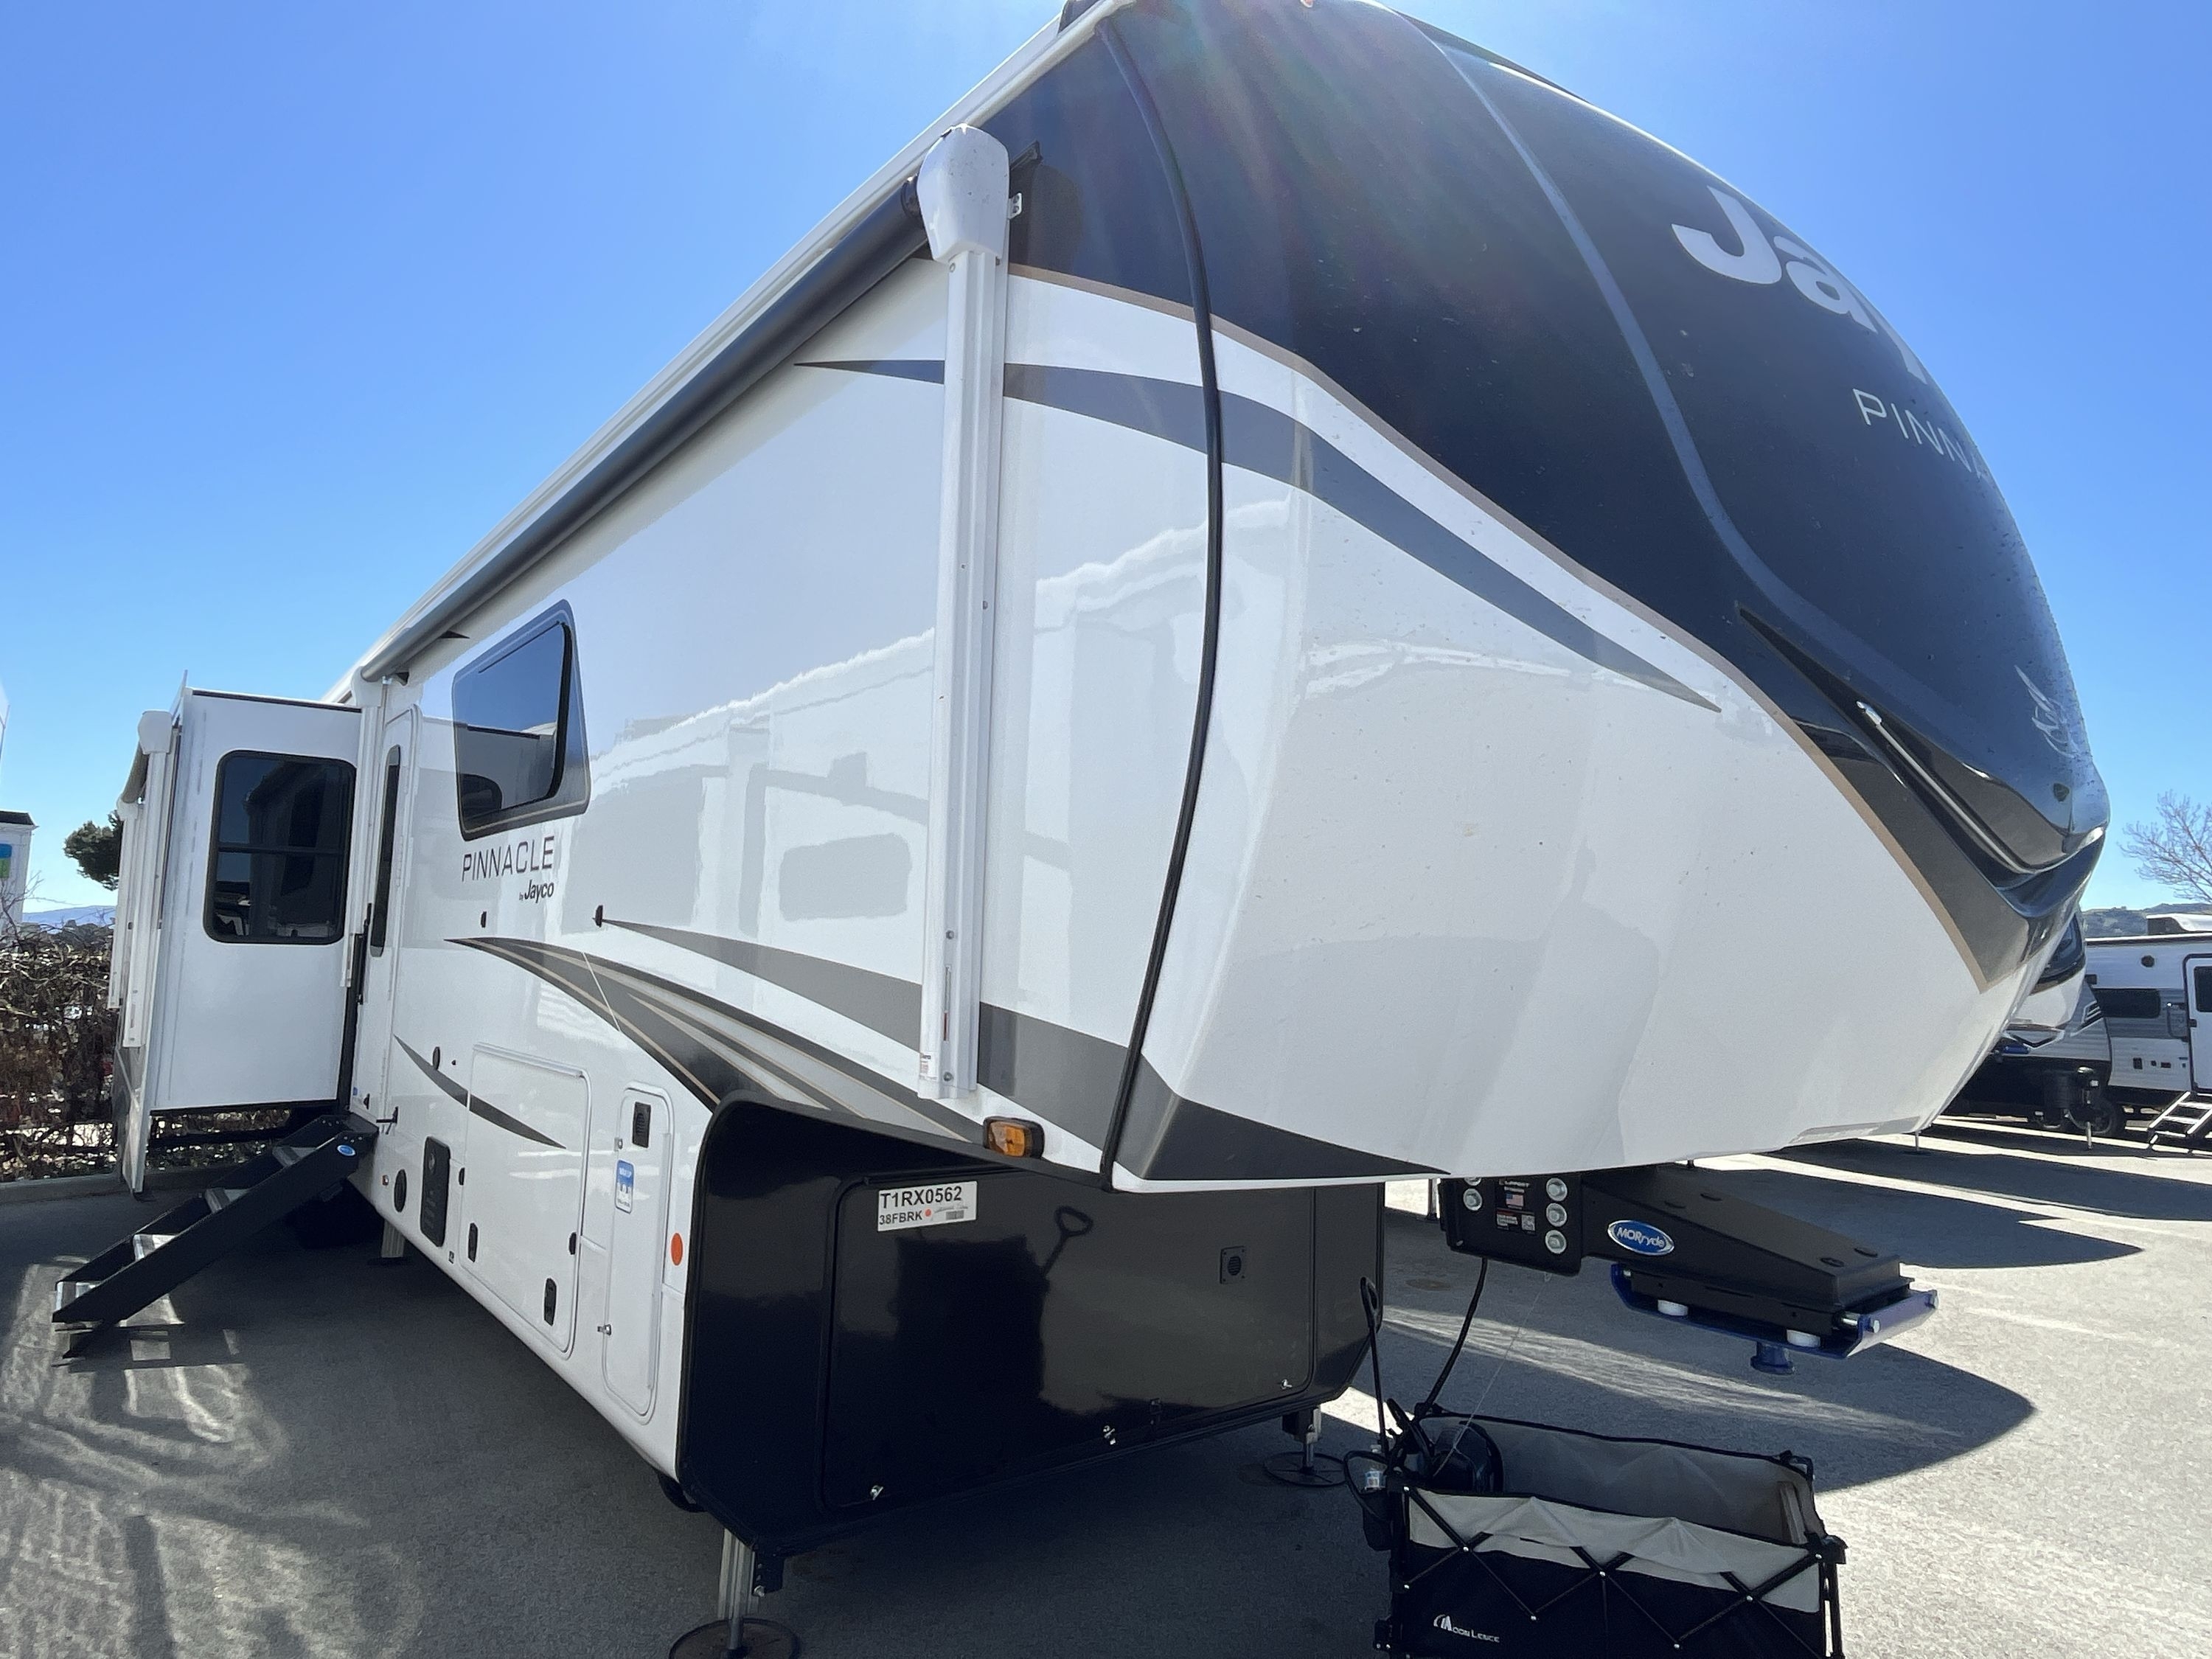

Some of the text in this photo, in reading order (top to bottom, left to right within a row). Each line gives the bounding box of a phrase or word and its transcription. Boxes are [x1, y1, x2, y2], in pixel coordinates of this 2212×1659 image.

[1853, 389, 1983, 479] PINN
[462, 835, 554, 881] PINNACLE
[524, 880, 554, 903] Jayco
[880, 1186, 961, 1208] T1RX0562
[879, 1211, 922, 1225] 38FBRK
